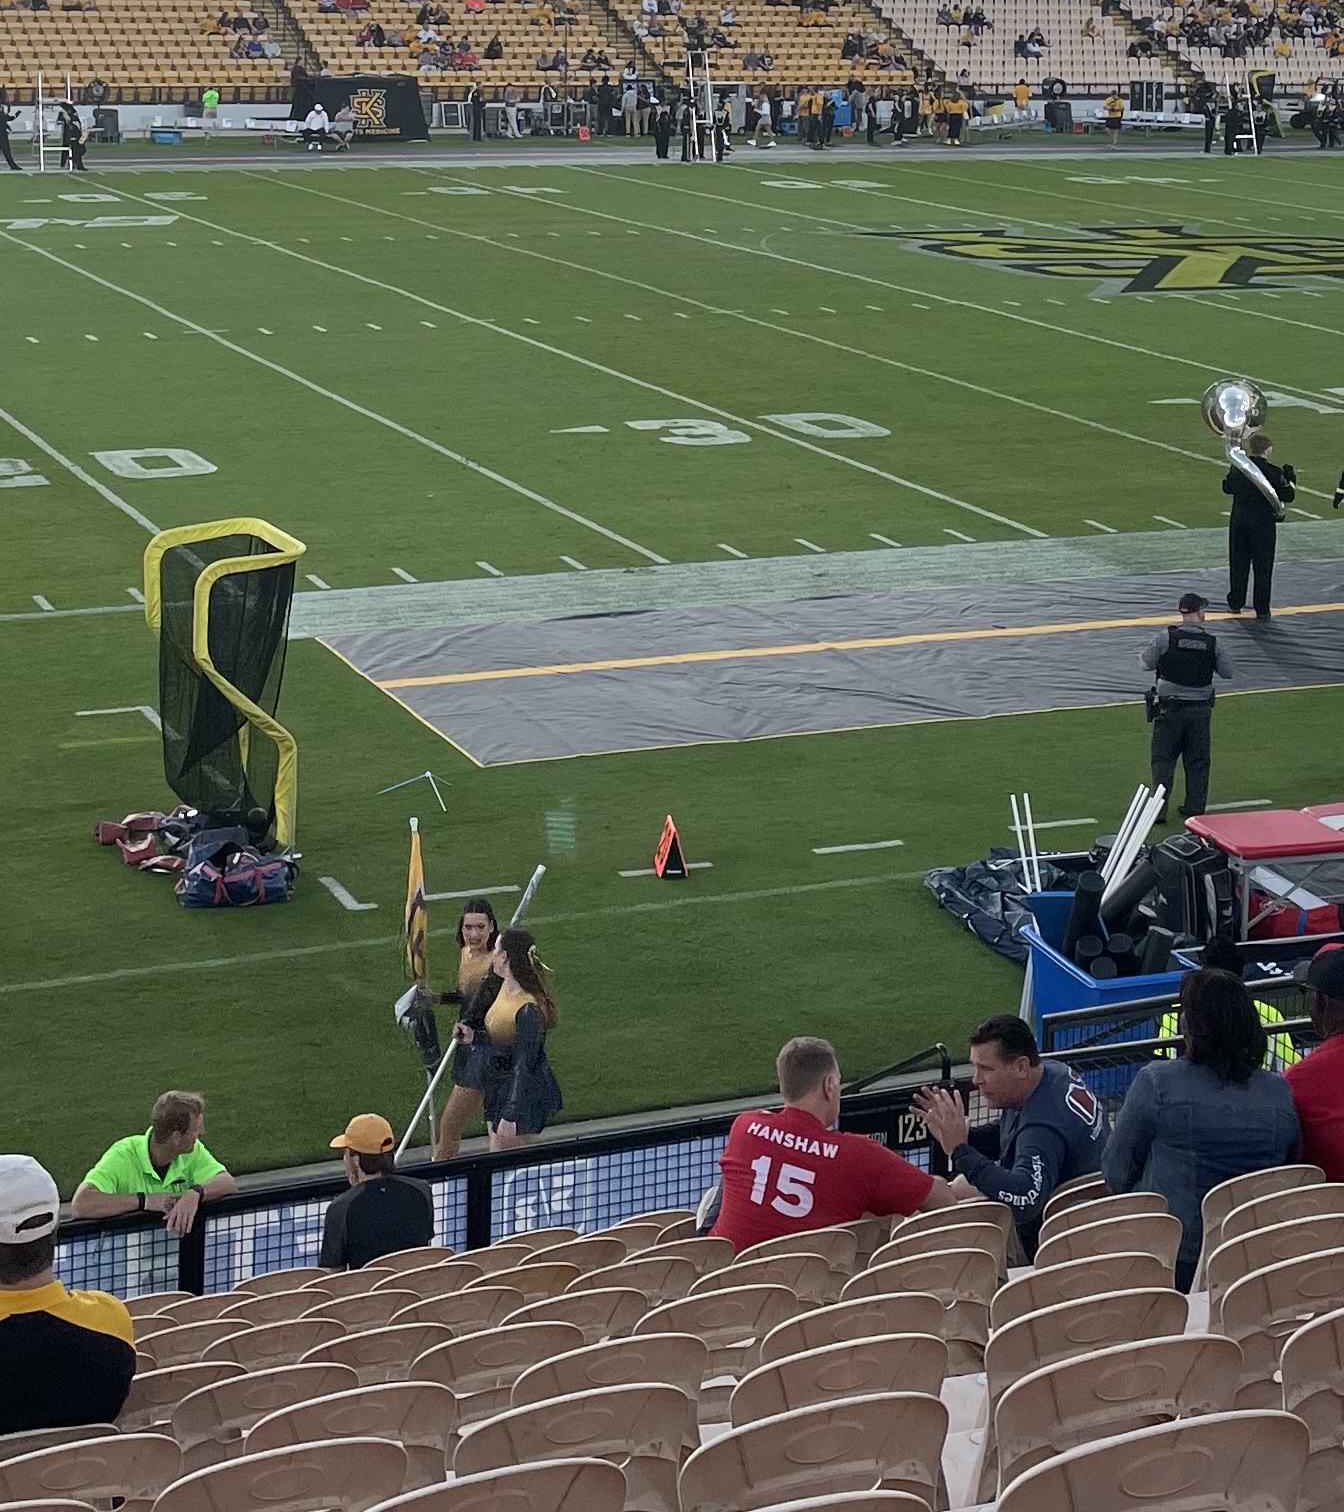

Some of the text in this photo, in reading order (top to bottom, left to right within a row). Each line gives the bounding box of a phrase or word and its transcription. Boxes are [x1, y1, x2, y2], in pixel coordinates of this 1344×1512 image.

[747, 1121, 840, 1159] HANSHAW
[898, 1113, 927, 1144] 123
[750, 1155, 816, 1218] 15
